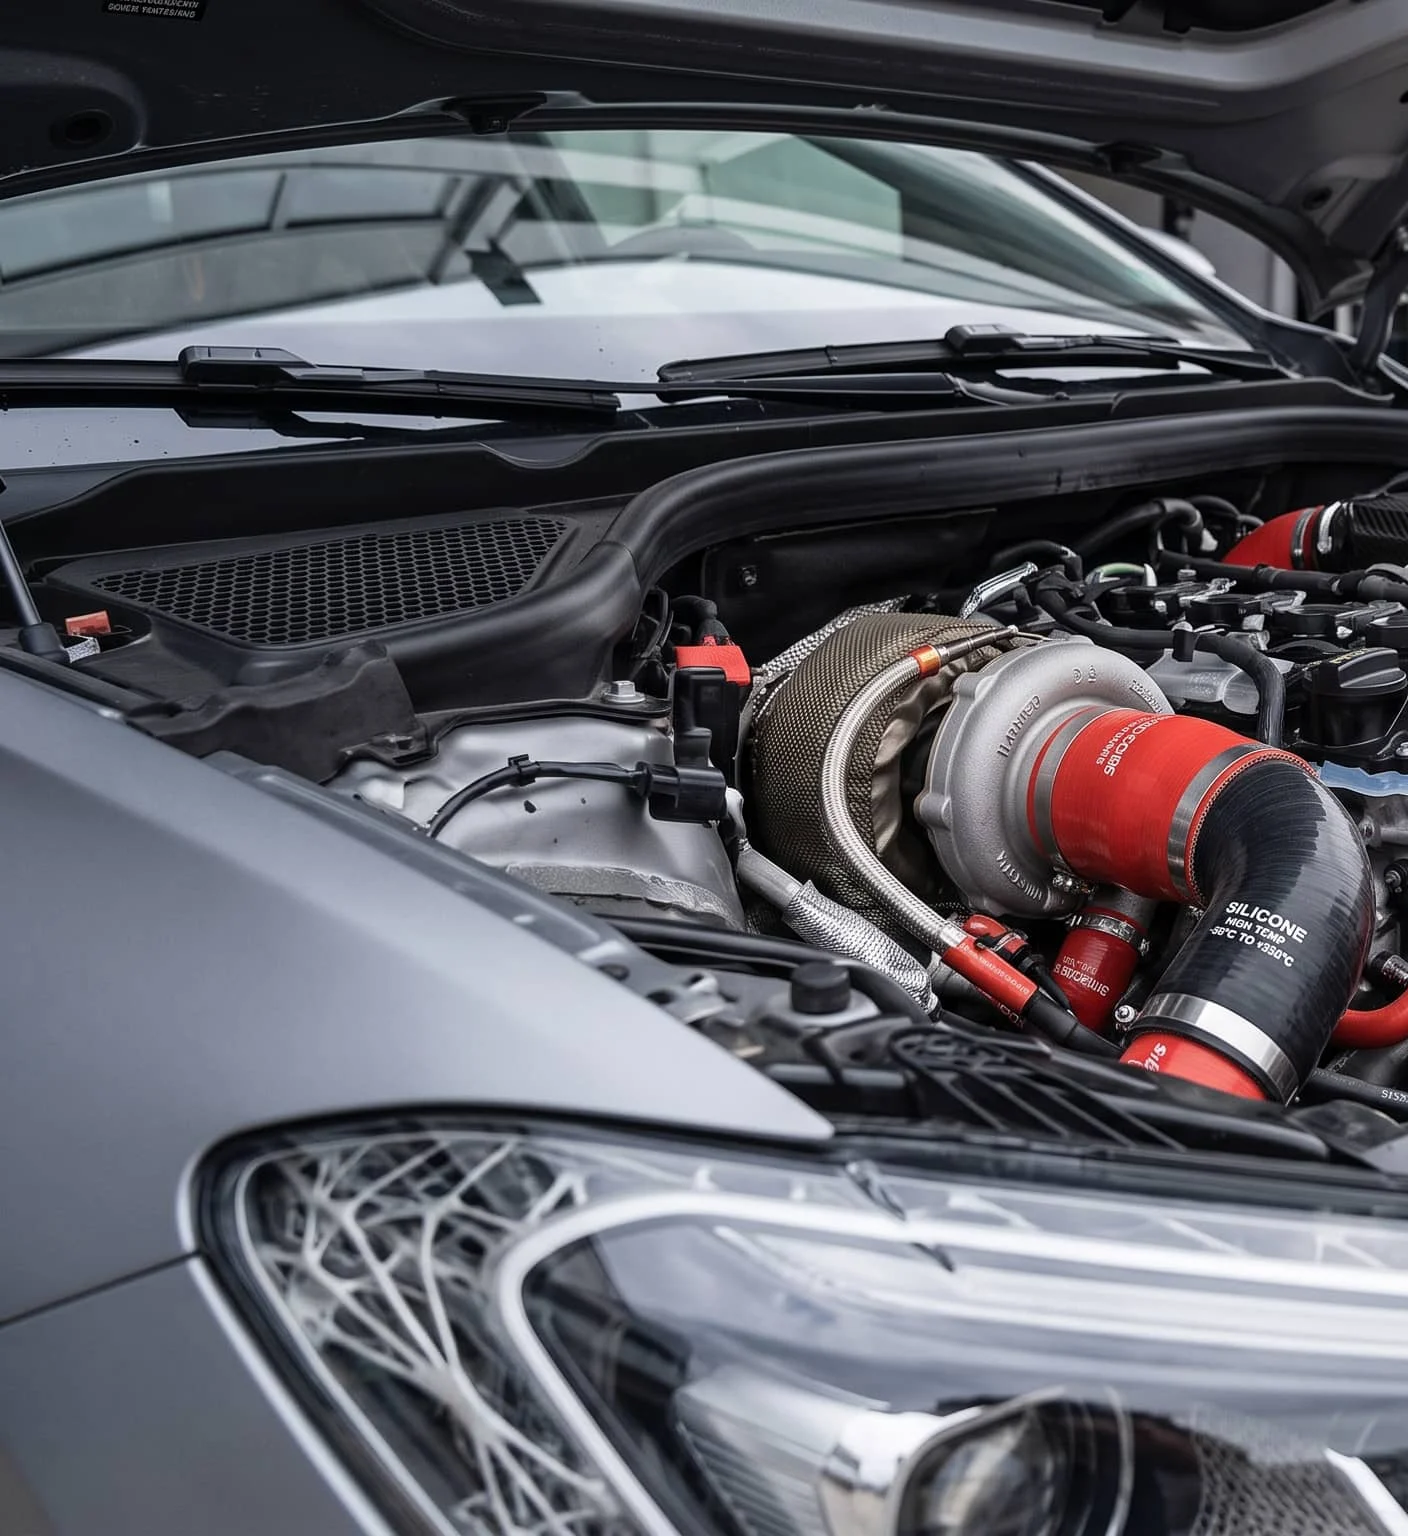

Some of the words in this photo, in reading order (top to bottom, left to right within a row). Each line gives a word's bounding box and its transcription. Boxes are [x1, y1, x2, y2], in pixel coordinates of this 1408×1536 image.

[1226, 902, 1308, 944] SILICONE
[1240, 932, 1255, 945] TO
[1255, 924, 1286, 945] TEMP
